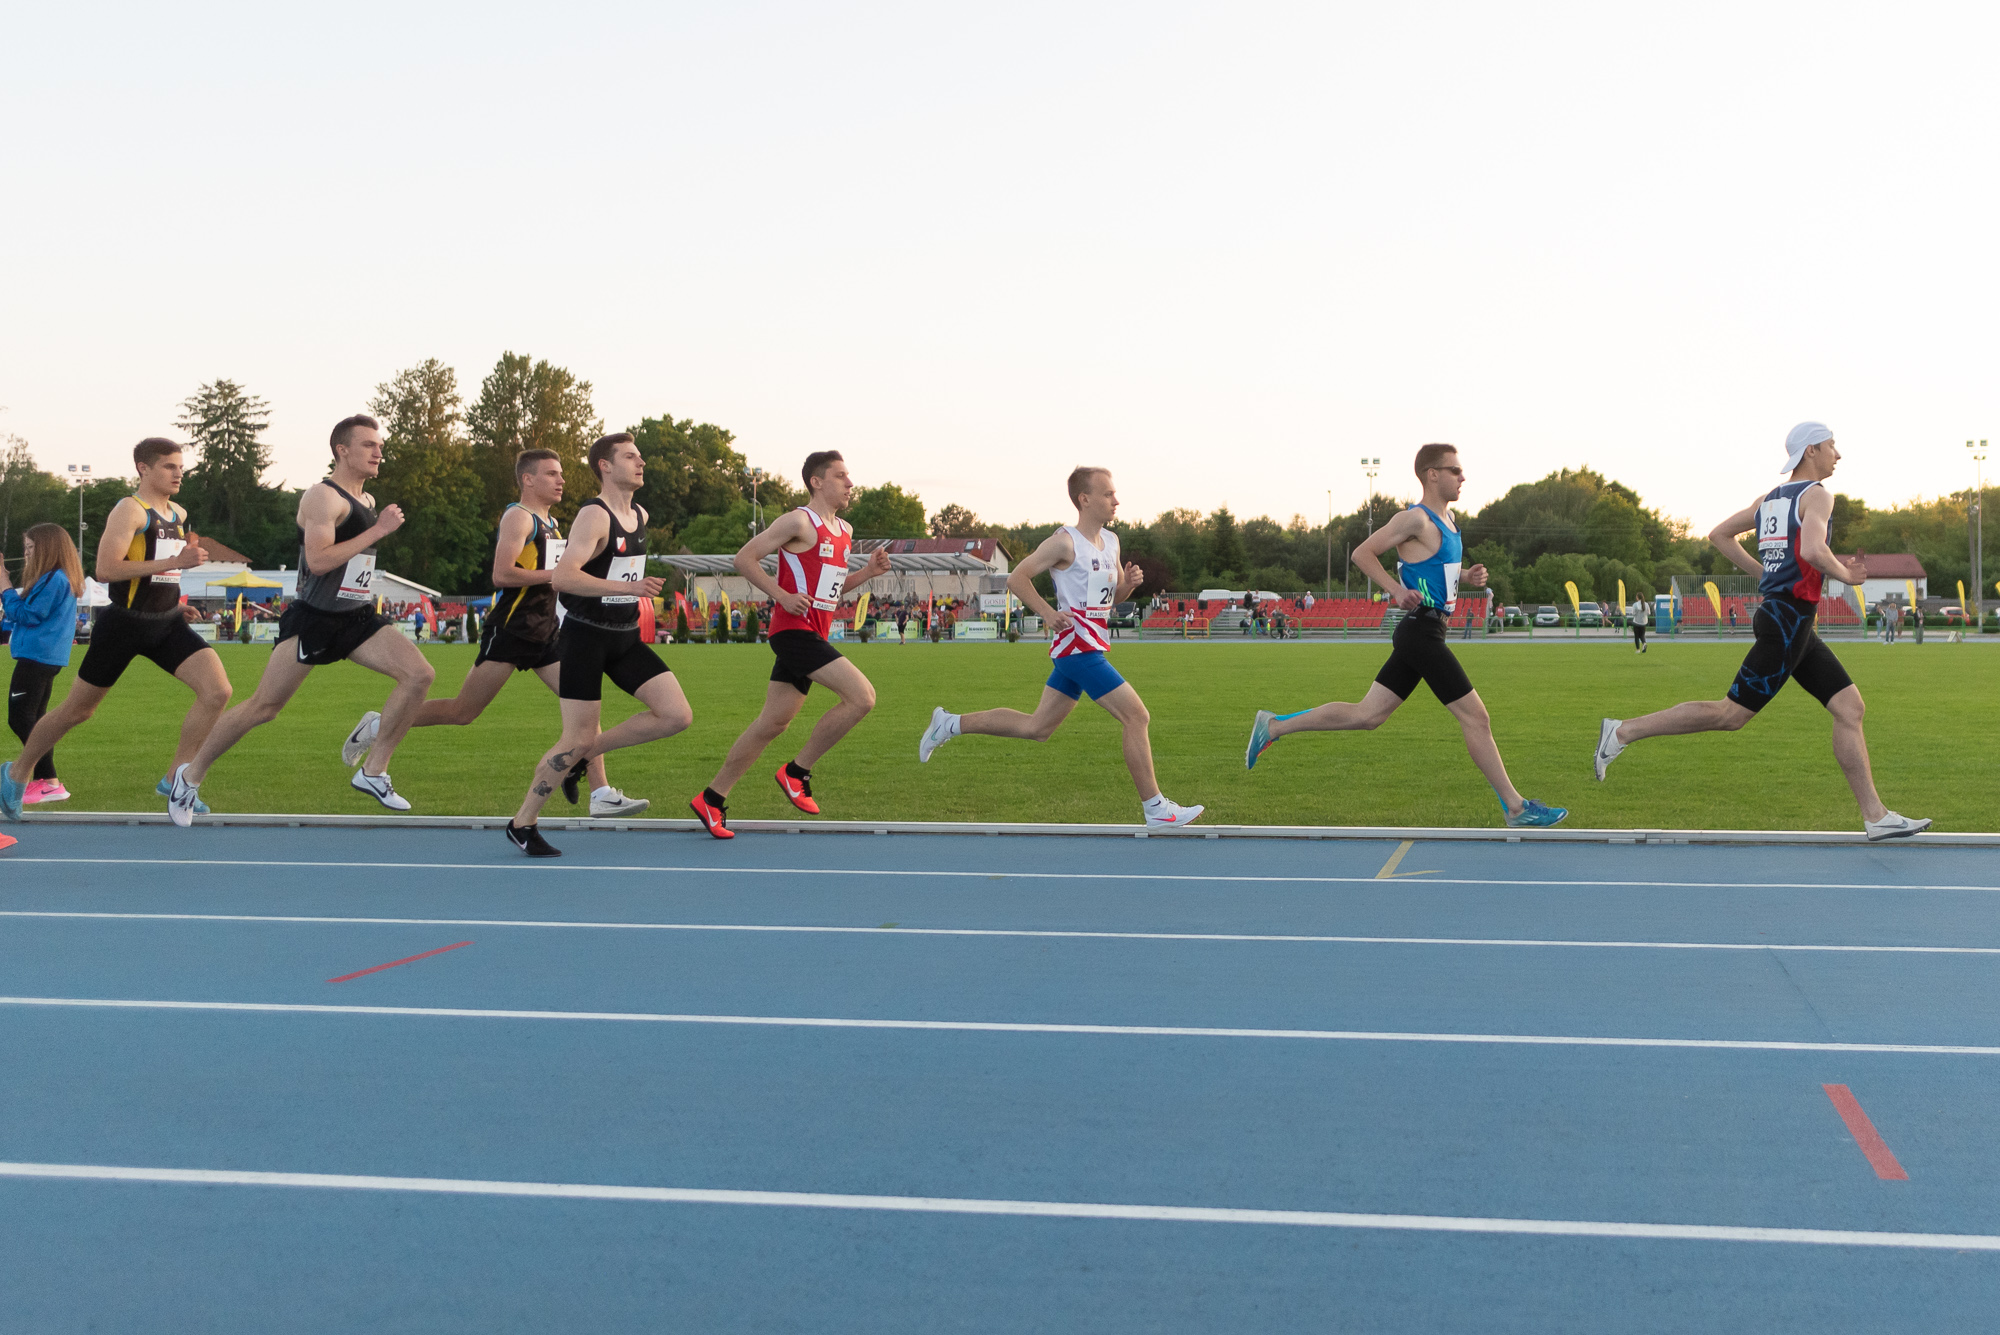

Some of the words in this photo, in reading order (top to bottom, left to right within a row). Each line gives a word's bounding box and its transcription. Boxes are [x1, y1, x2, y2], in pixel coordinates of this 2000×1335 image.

[1764, 516, 1778, 535] 33
[355, 571, 371, 587] 42
[1100, 587, 1114, 605] 26
